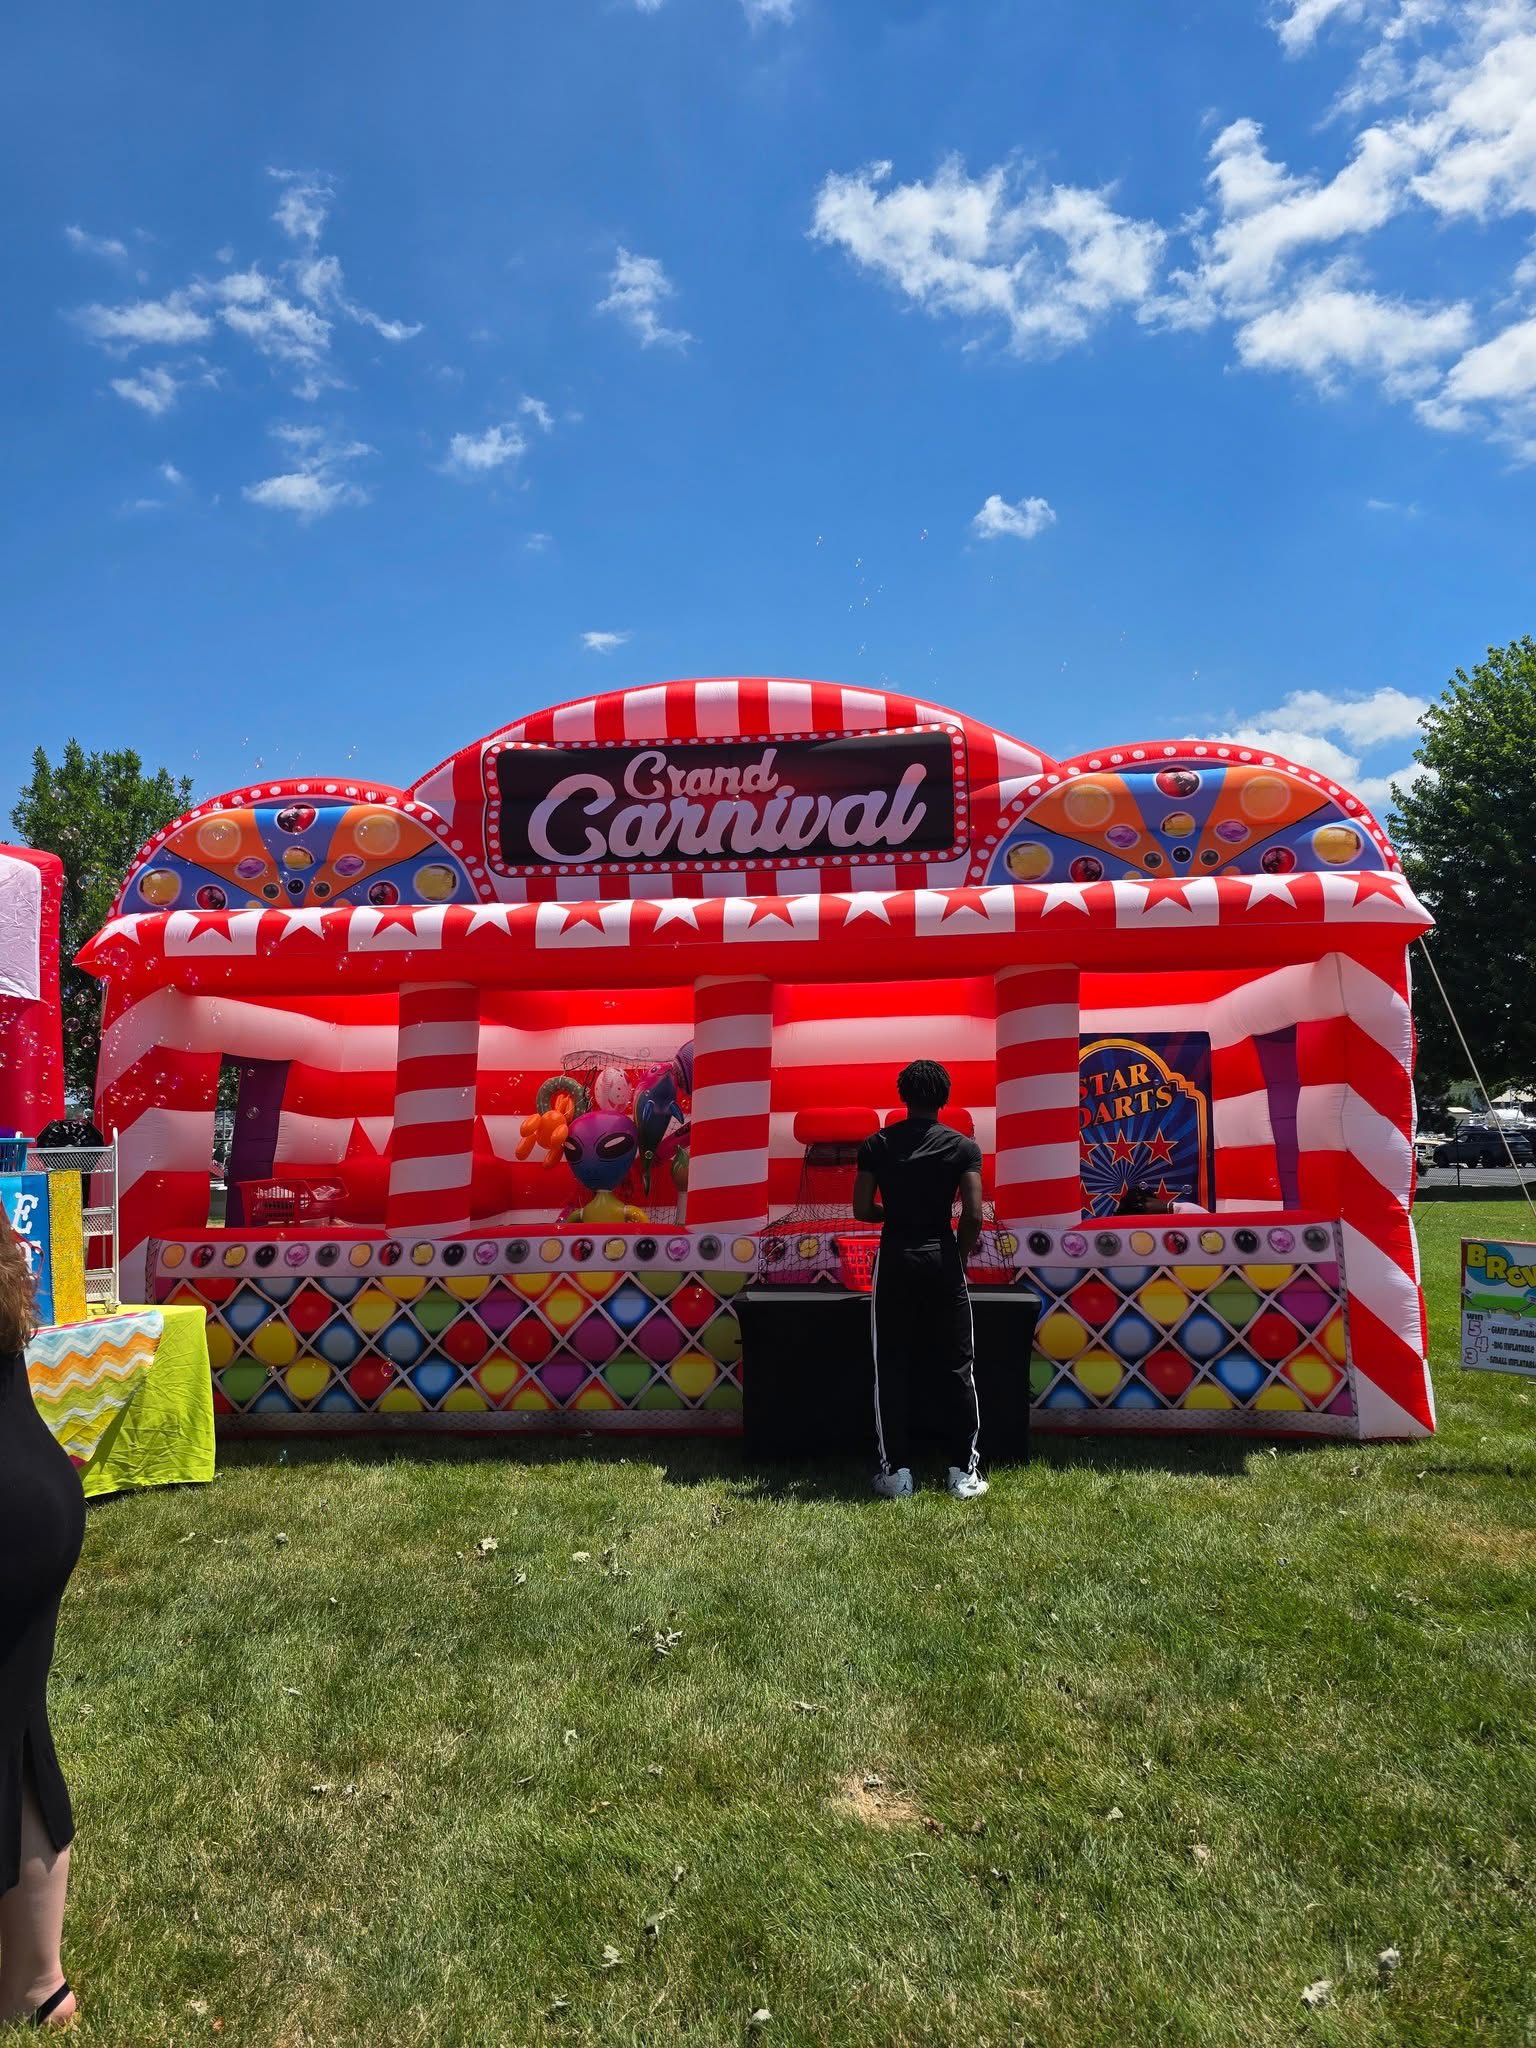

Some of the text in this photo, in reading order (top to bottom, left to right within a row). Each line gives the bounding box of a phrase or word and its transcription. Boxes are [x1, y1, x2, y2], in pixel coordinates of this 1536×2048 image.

[623, 748, 779, 800] Grand
[527, 763, 927, 864] Carnival
[1464, 1347, 1478, 1365] 3
[1475, 1336, 1488, 1353] 4
